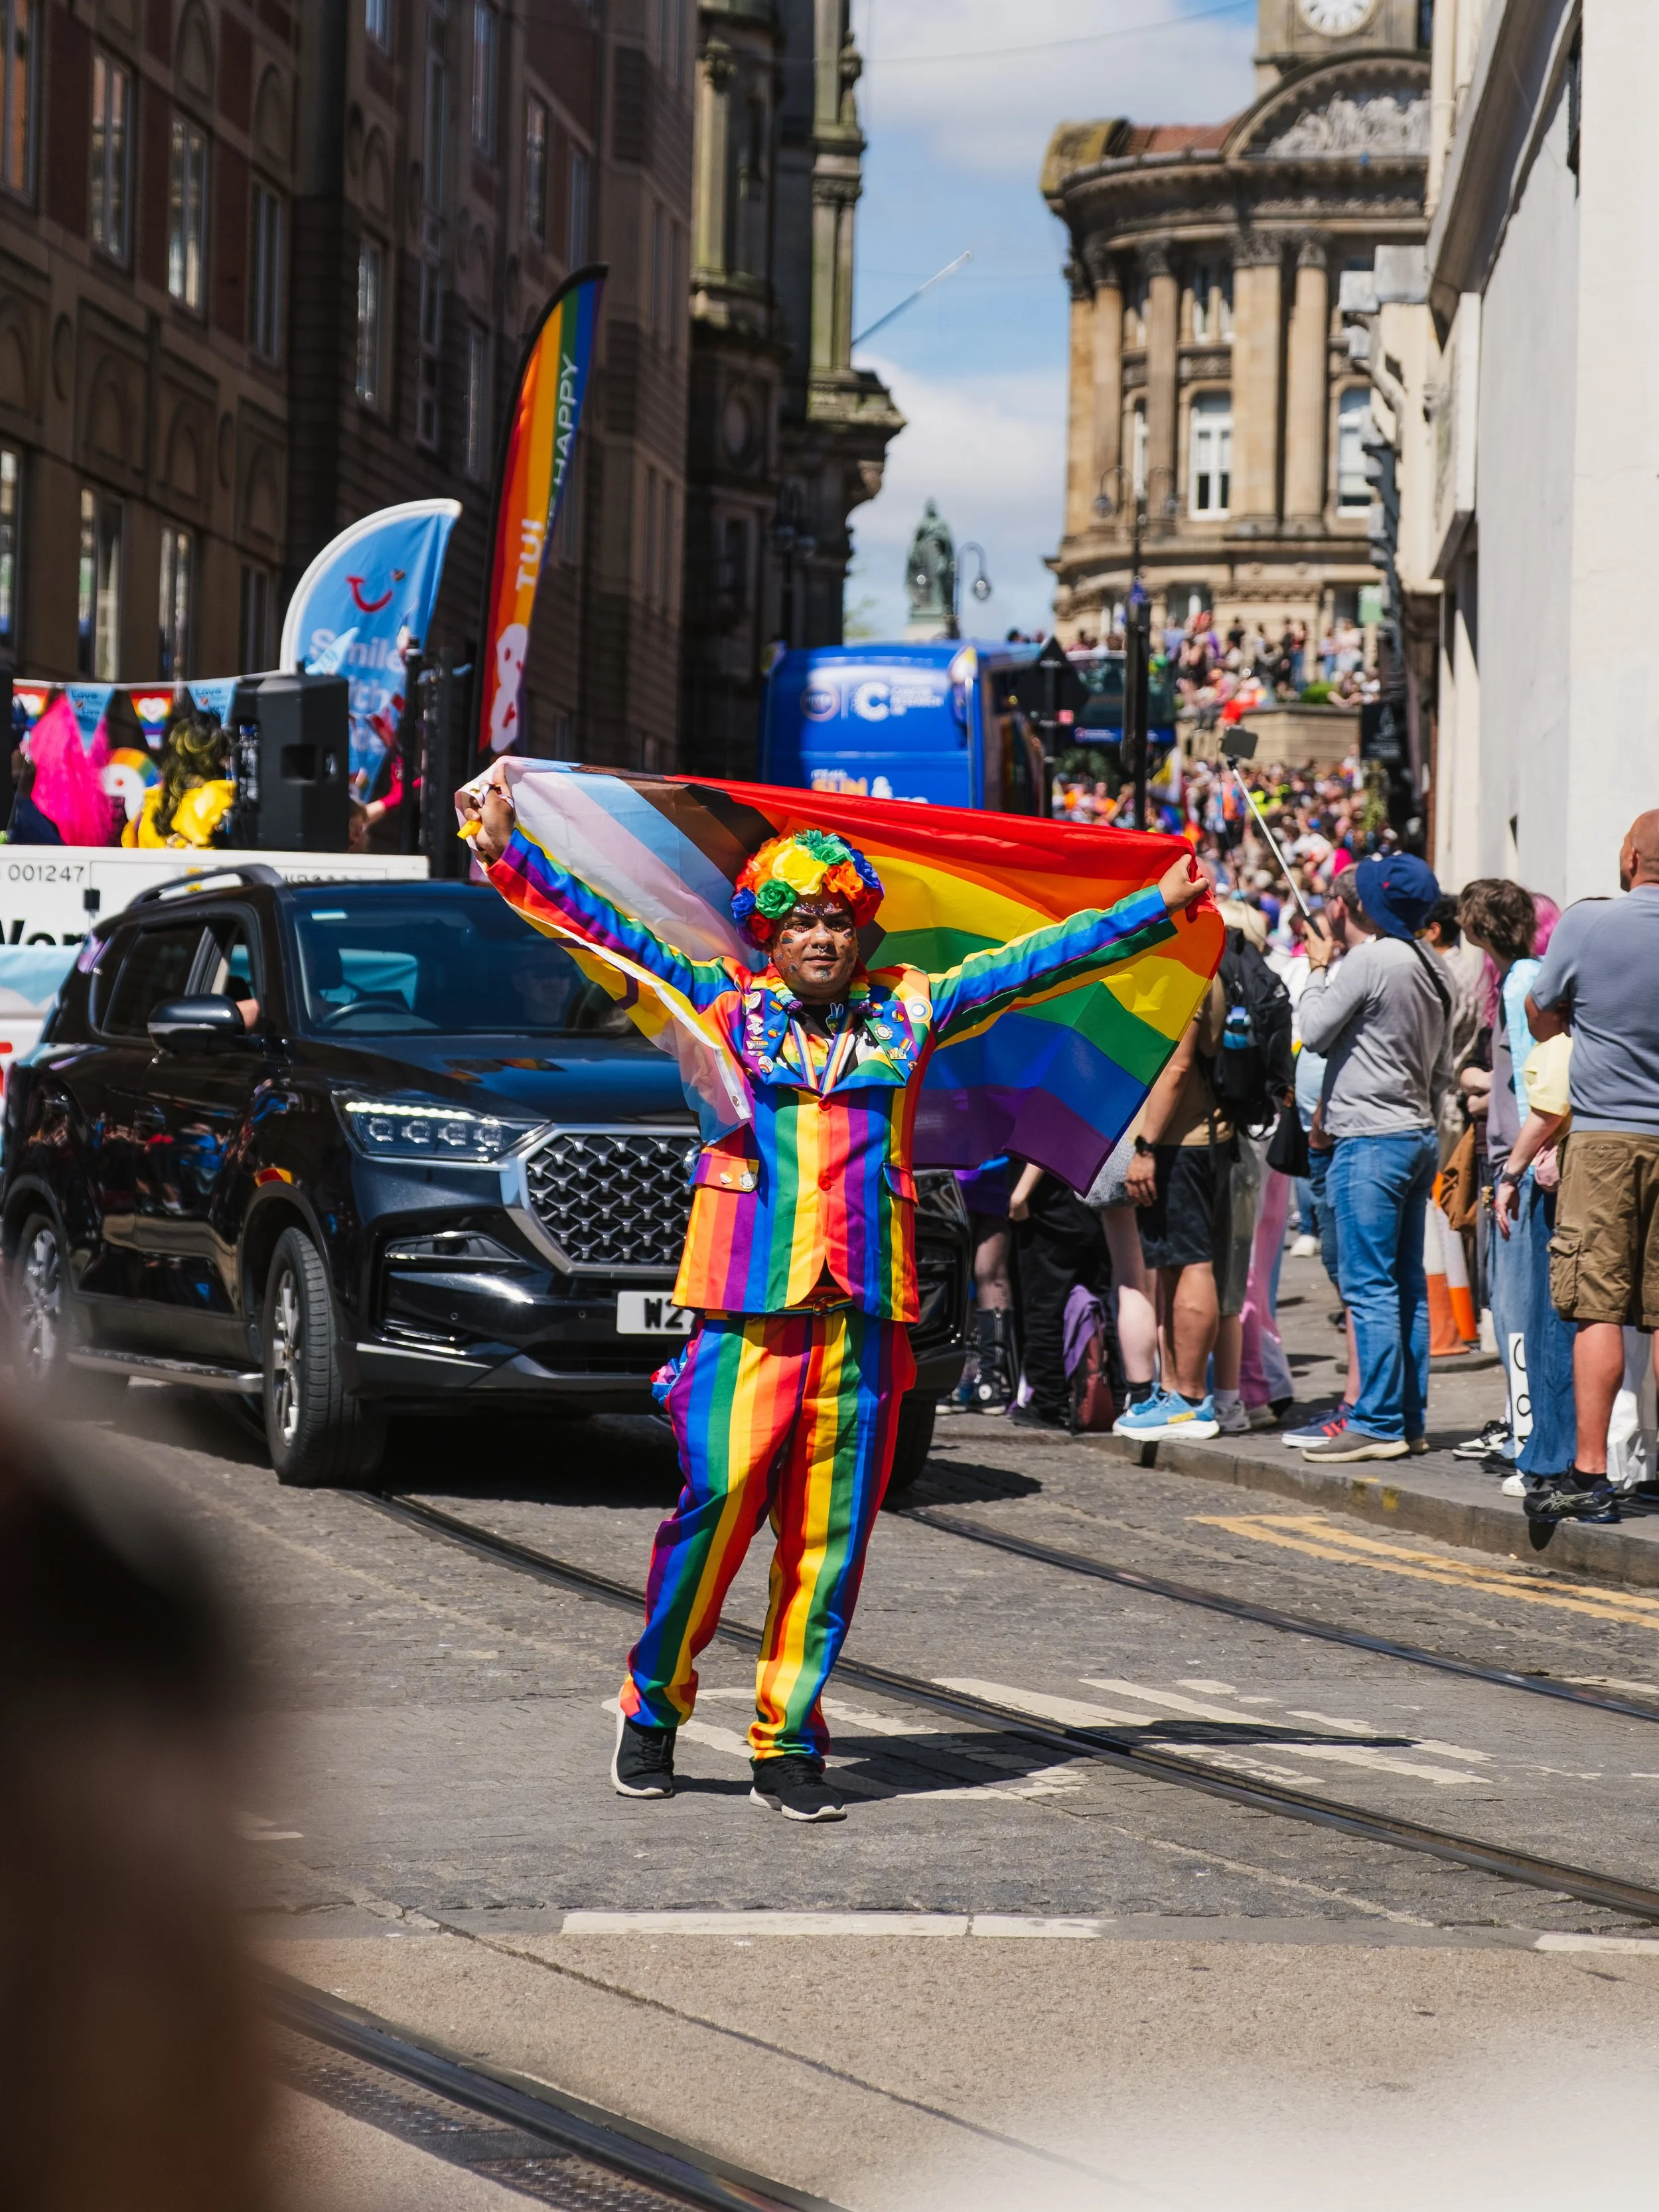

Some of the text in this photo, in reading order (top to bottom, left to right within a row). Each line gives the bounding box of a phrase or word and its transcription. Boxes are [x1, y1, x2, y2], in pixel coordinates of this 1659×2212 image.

[553, 352, 578, 485] HAPPY
[516, 518, 543, 591] TUI
[309, 628, 405, 674] Smile
[348, 676, 392, 711] ith
[8, 863, 84, 883] 001247
